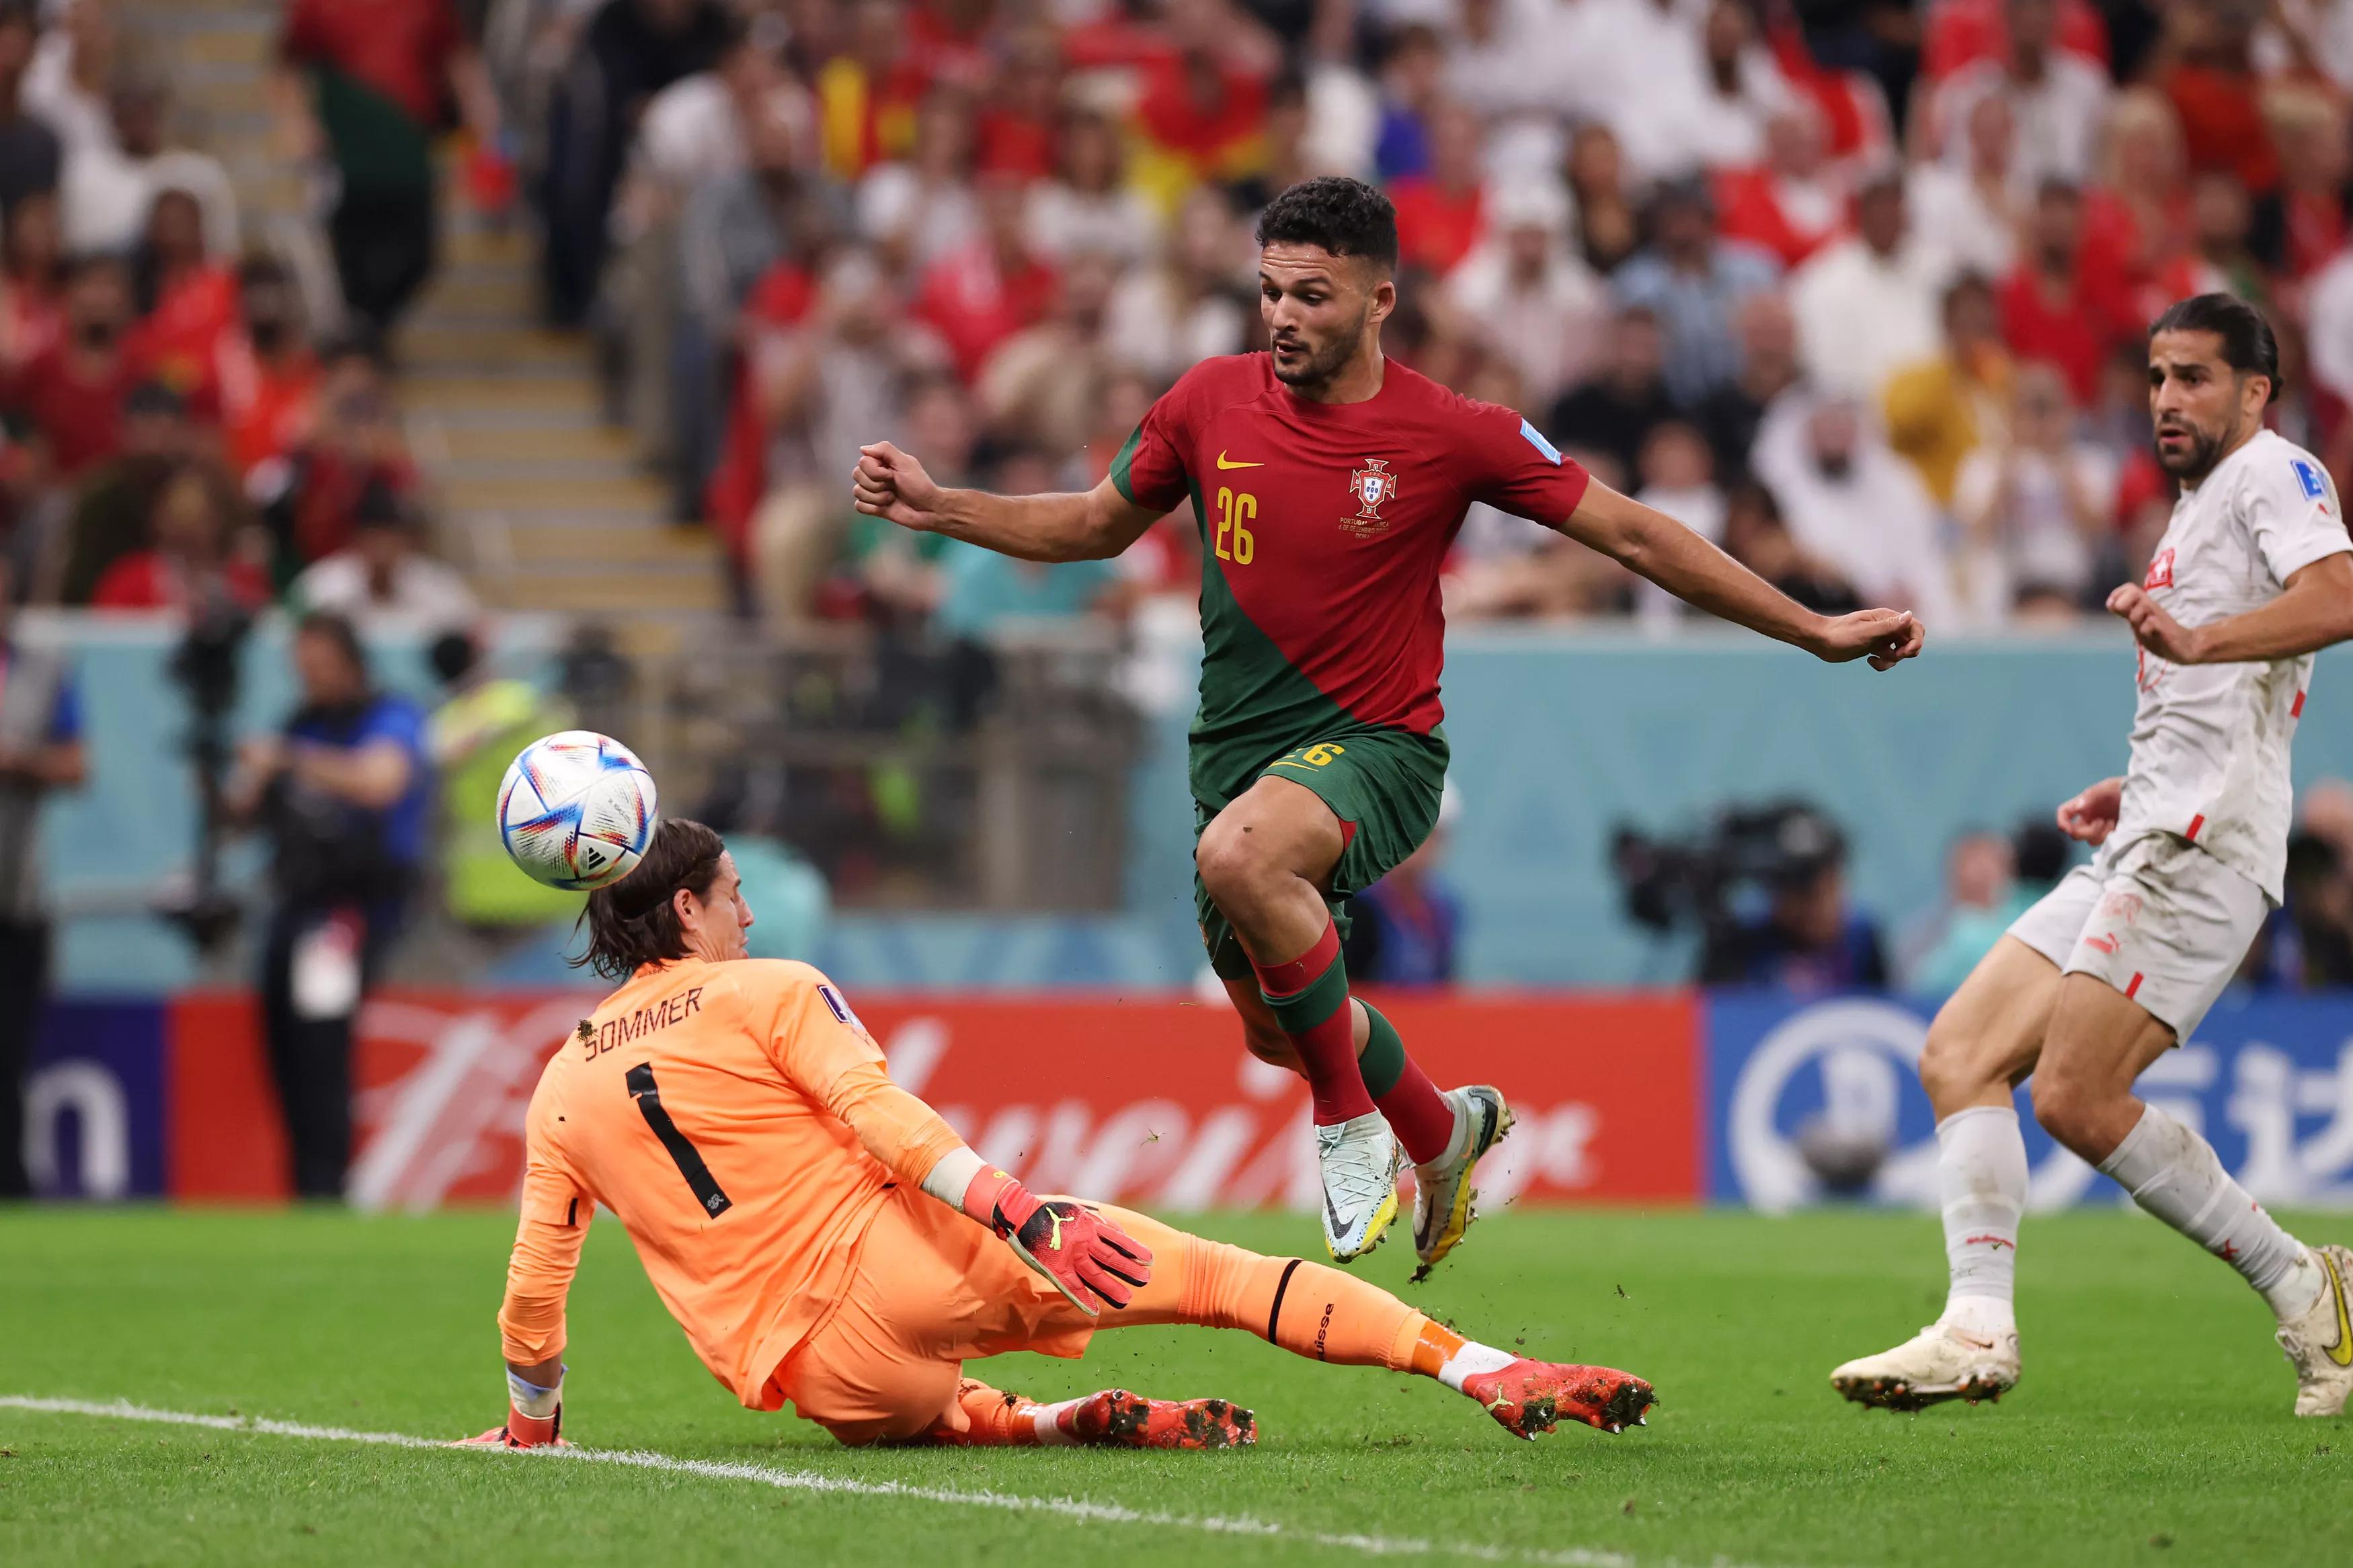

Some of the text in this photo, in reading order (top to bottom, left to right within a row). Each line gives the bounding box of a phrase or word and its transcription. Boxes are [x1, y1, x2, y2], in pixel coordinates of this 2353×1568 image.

[1215, 487, 1257, 565] 26
[584, 987, 704, 1062] SOMMER
[625, 1061, 733, 1220] 1
